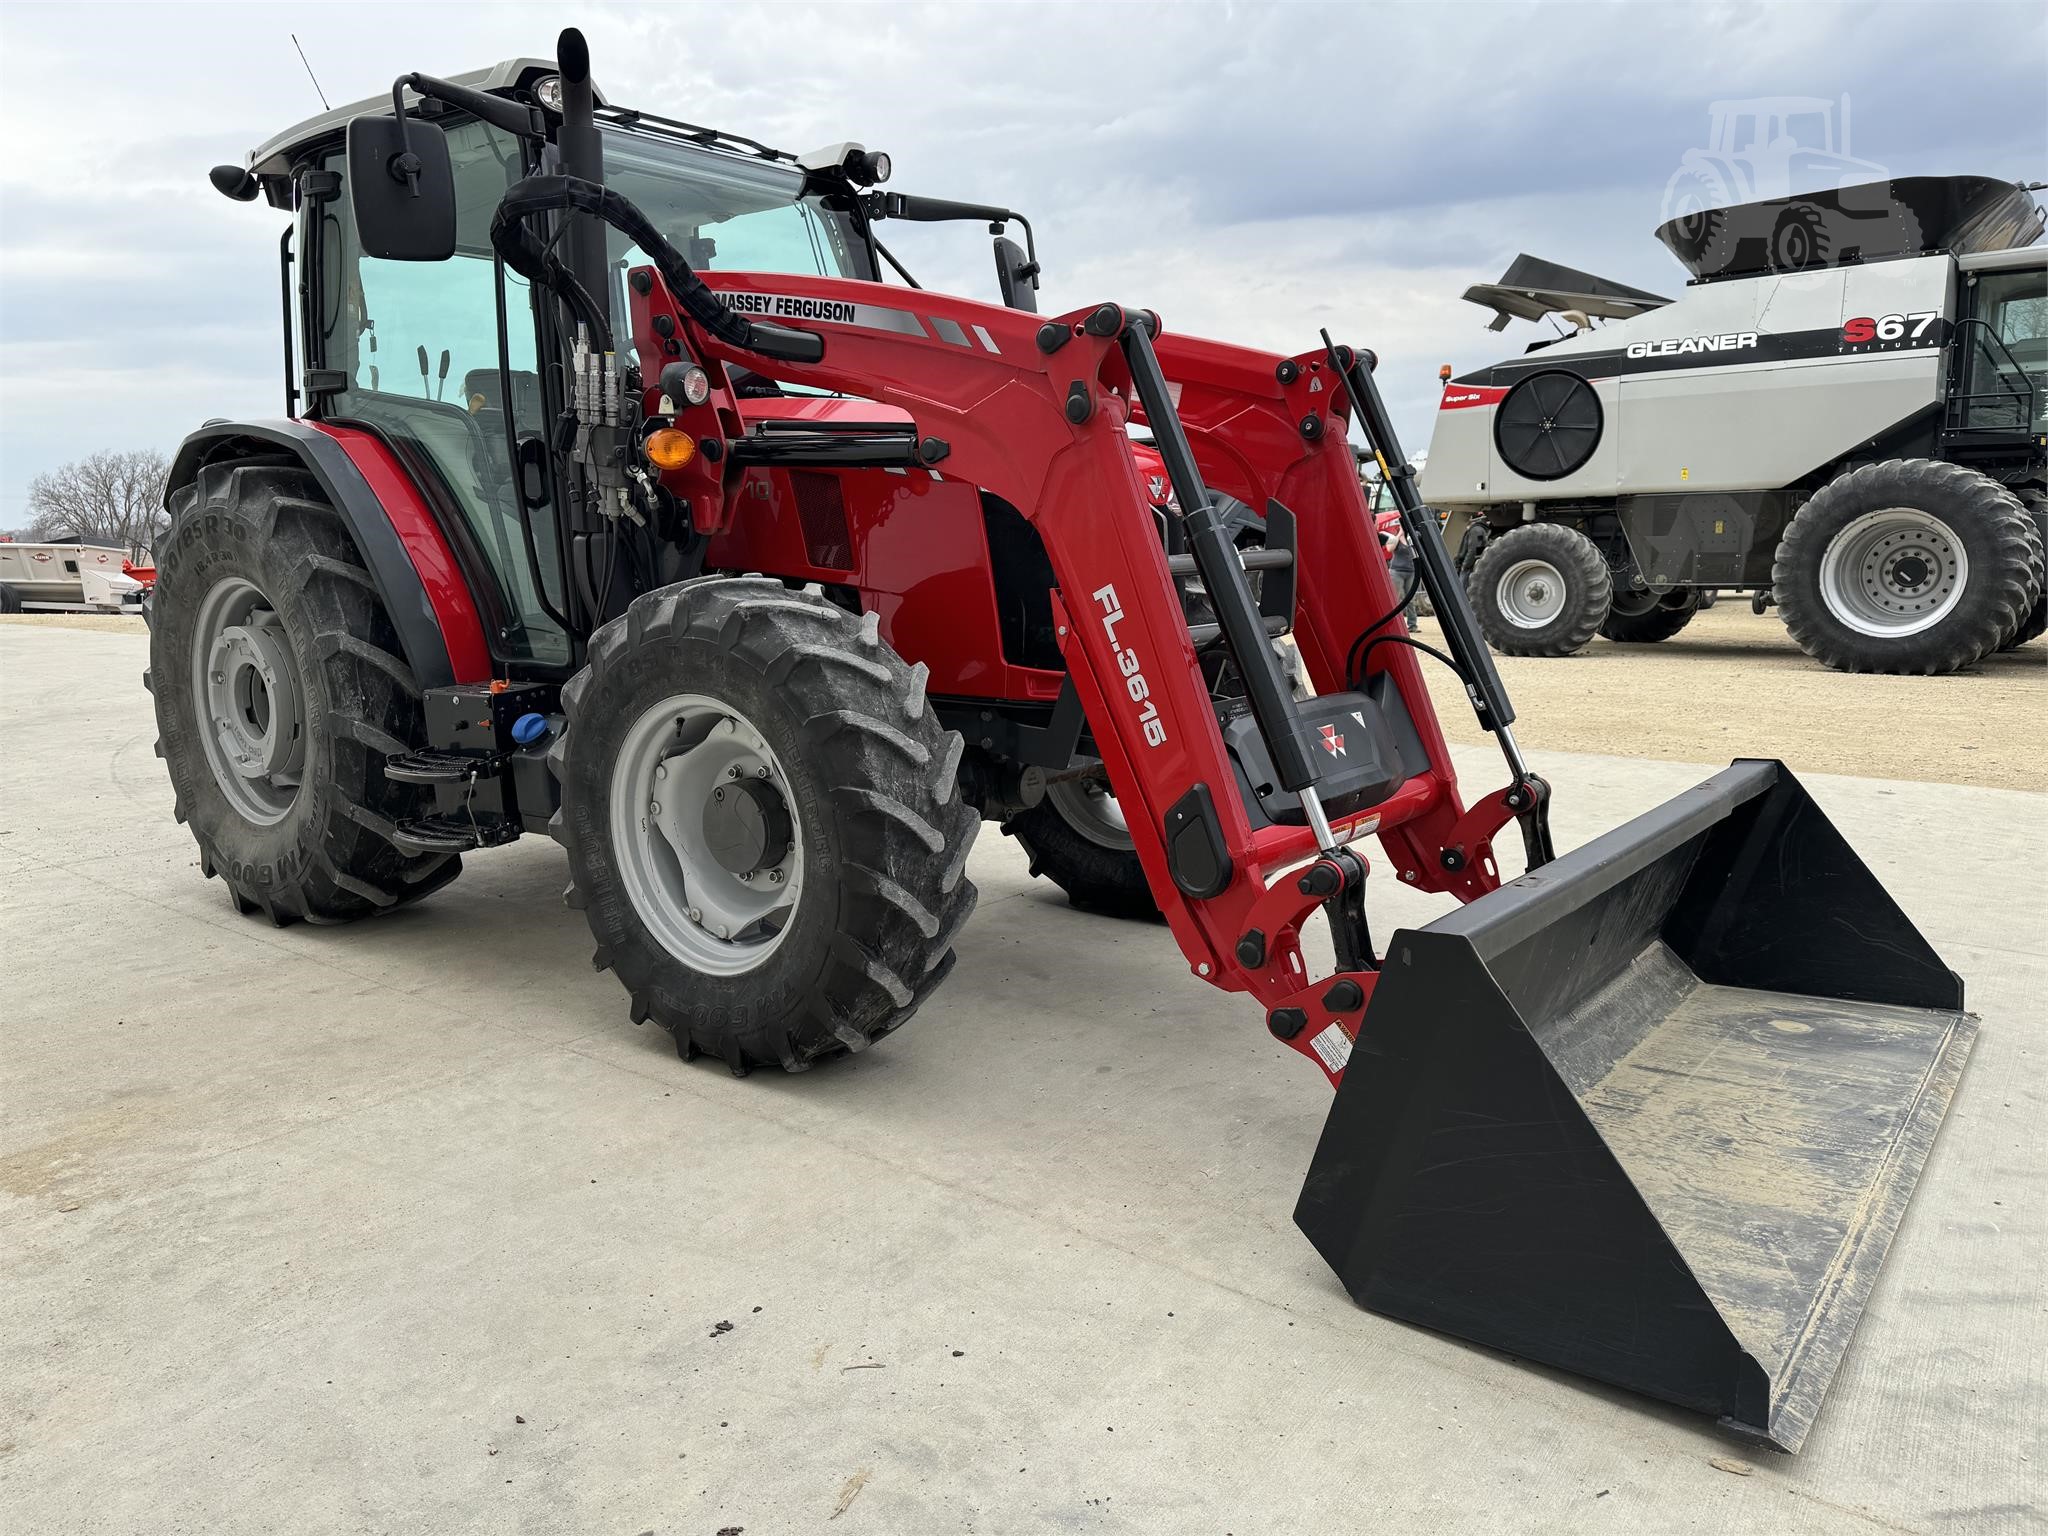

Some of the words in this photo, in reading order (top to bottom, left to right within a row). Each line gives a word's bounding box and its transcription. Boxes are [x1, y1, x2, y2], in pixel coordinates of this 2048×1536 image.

[715, 293, 772, 313] MASSEY
[776, 297, 855, 323] FERGUSON
[1843, 310, 1938, 343] S67
[1626, 331, 1758, 360] GLEANER
[1838, 339, 1935, 352] TRITURA
[1092, 583, 1168, 748] FL.3615
